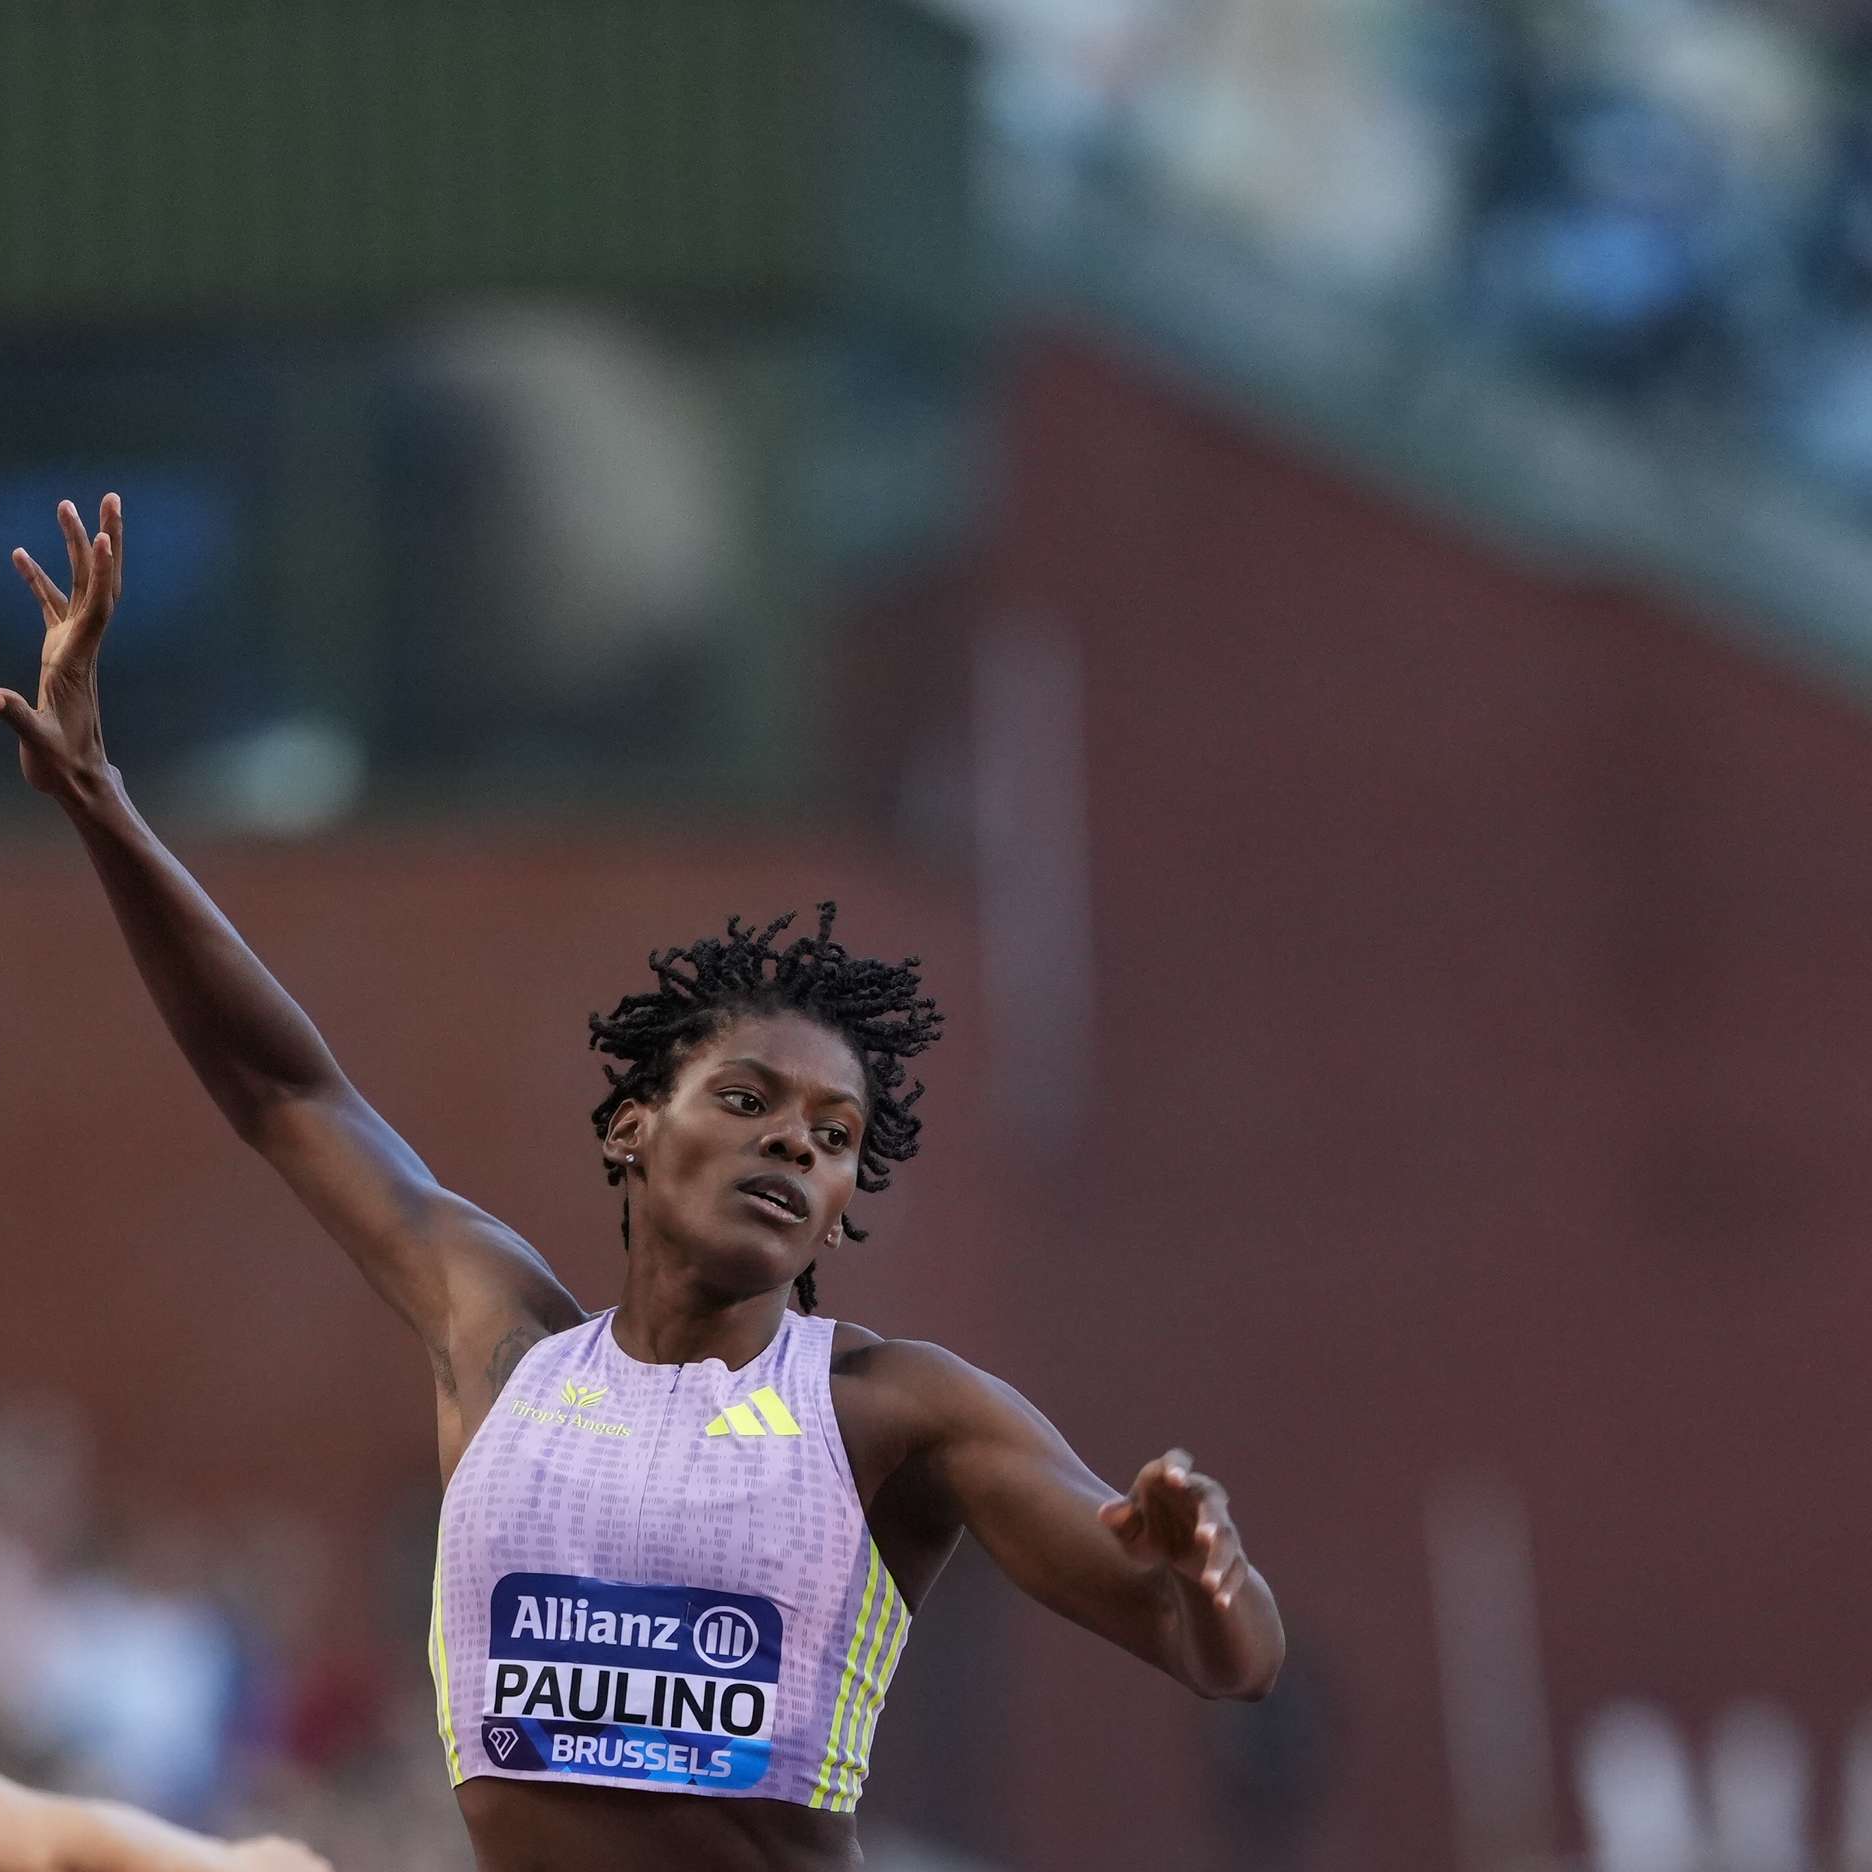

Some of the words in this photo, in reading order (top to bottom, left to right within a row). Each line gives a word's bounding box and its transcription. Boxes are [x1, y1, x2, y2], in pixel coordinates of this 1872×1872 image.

[511, 1400, 567, 1424] Tirop's
[569, 1413, 631, 1437] Angels
[510, 1595, 680, 1650] Allianz
[493, 1663, 765, 1736] PAULINO
[551, 1733, 732, 1777] BRUSSELS
